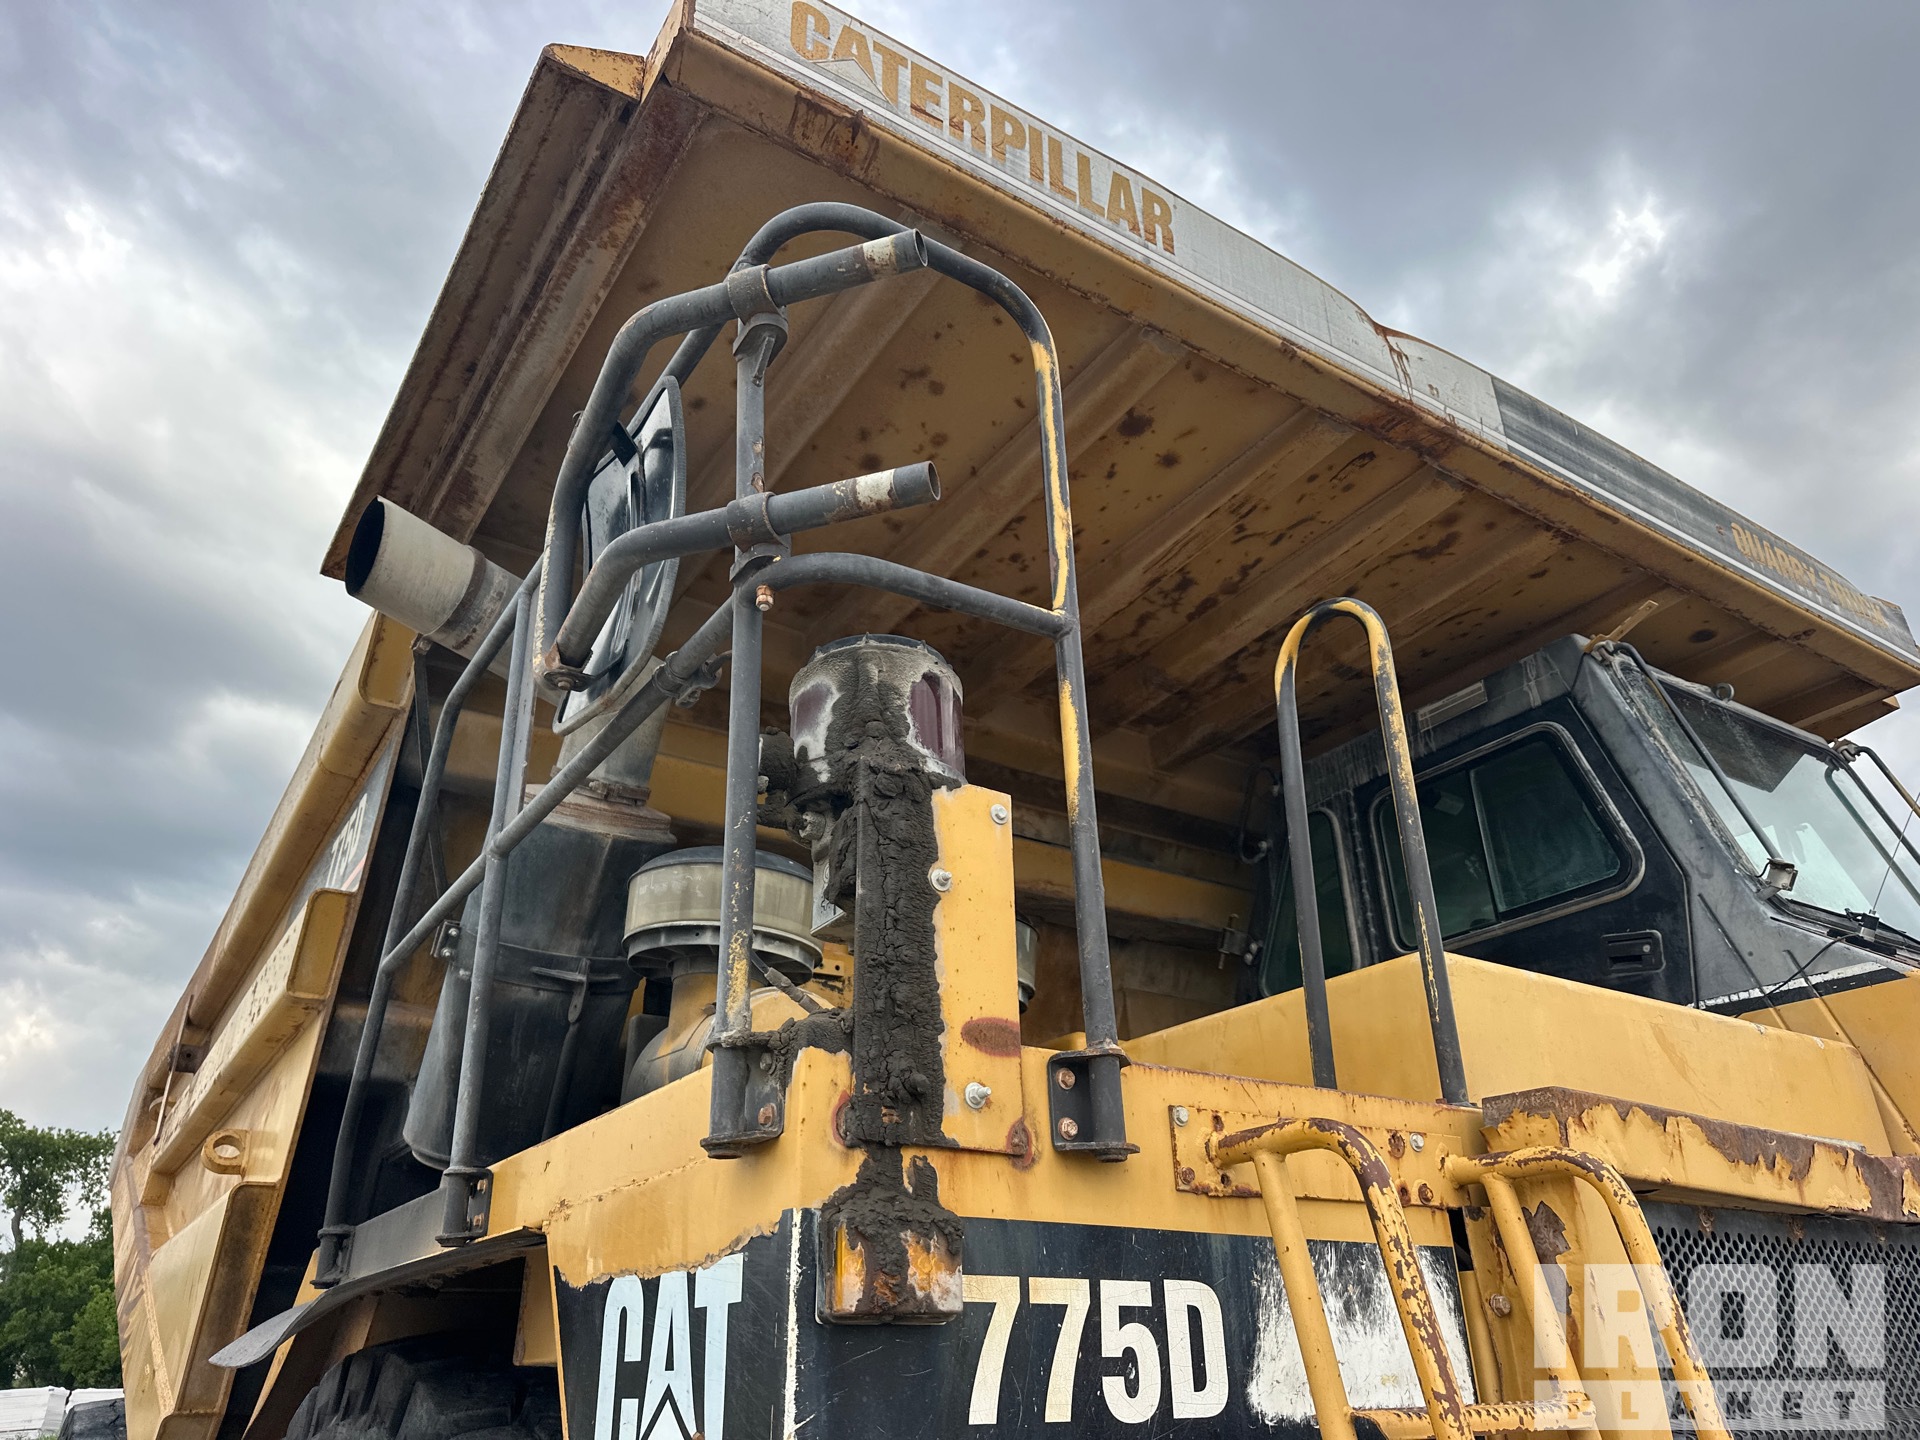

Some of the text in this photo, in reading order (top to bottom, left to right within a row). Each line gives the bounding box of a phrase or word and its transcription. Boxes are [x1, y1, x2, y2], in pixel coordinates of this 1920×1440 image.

[790, 1, 1176, 255] CATERPILLAR
[1730, 522, 1818, 588] QUARRY
[594, 1252, 744, 1440] CAT
[962, 1274, 1229, 1426] 775D
